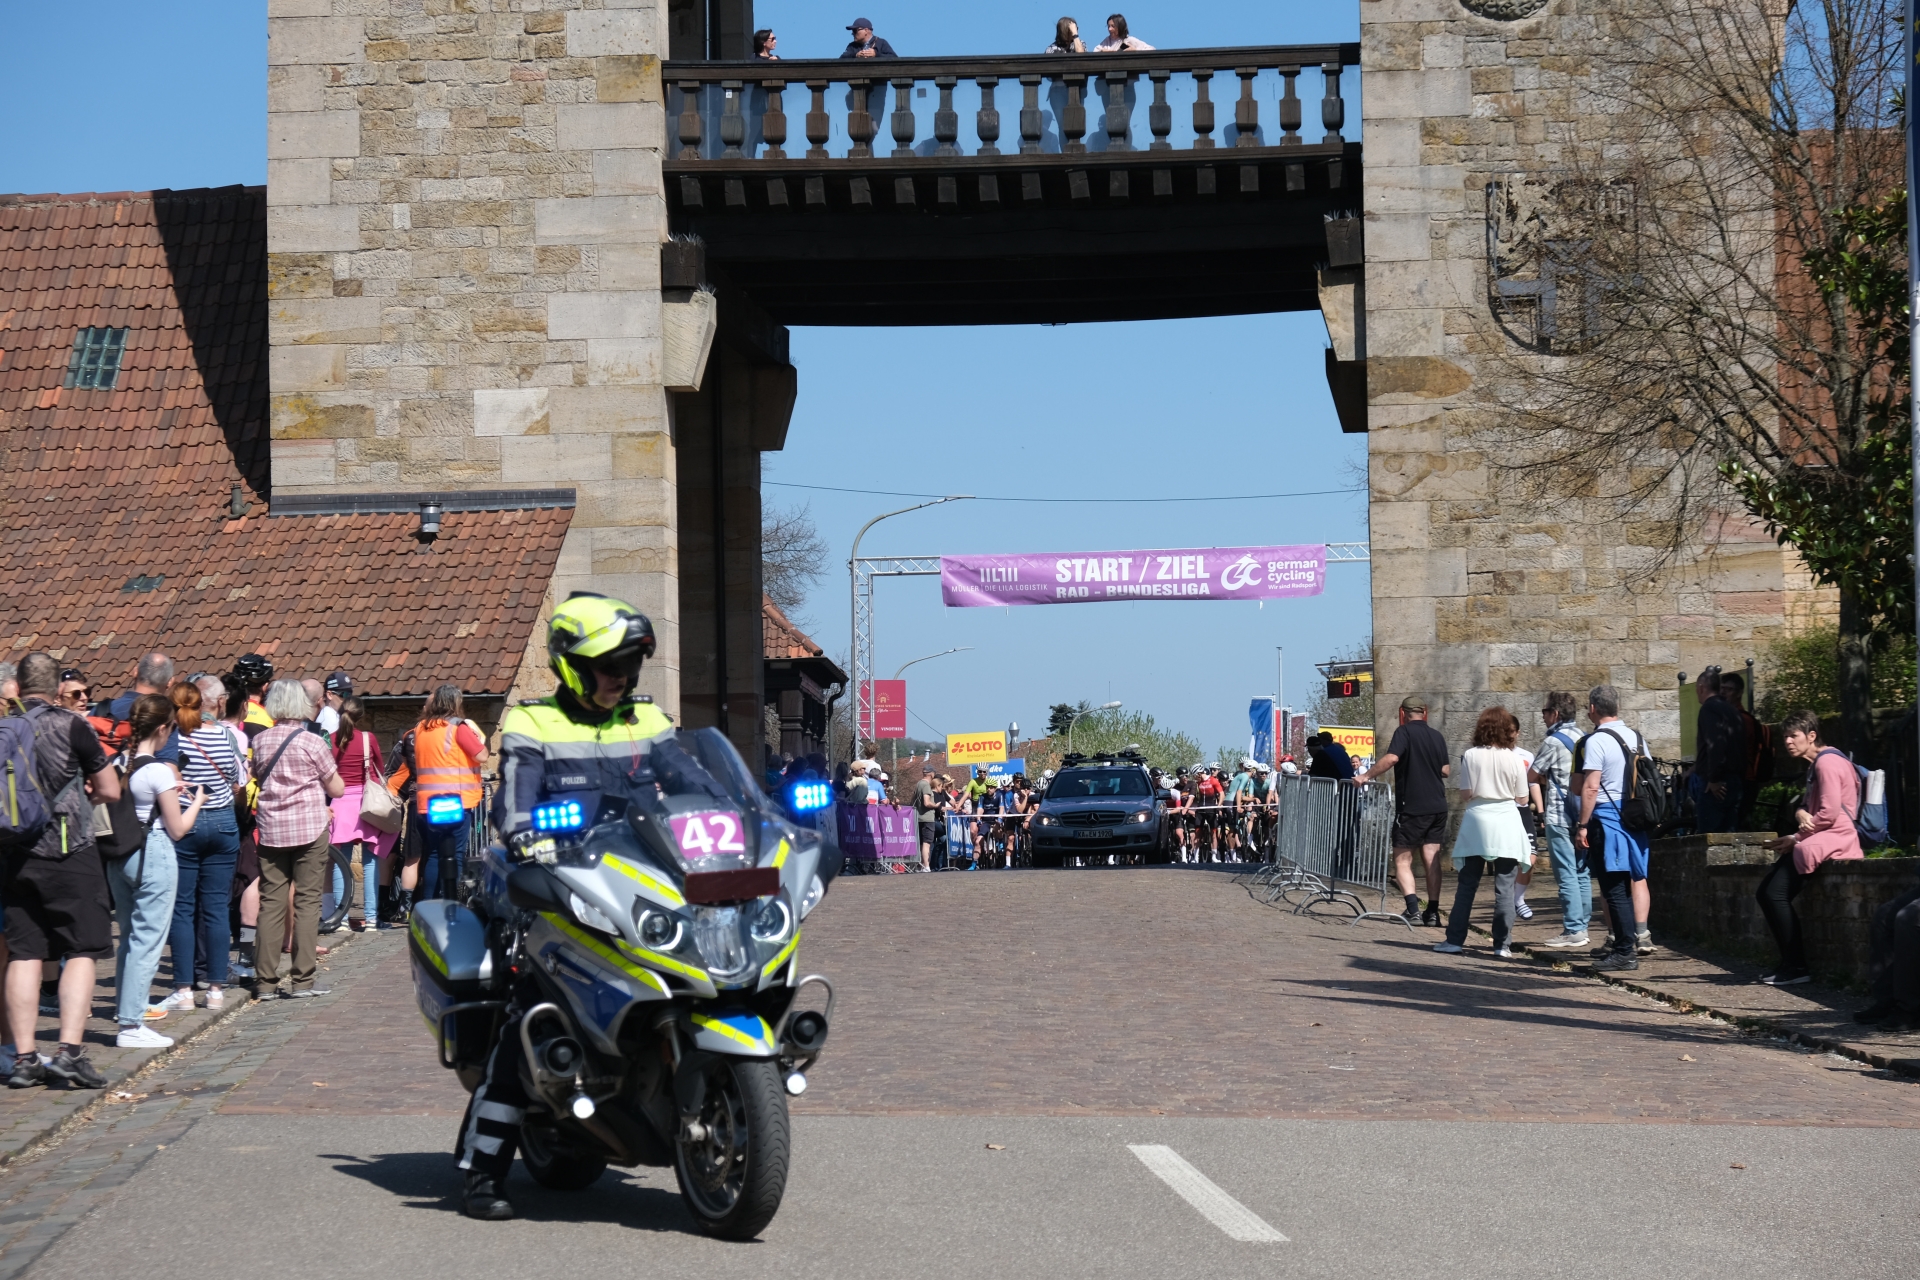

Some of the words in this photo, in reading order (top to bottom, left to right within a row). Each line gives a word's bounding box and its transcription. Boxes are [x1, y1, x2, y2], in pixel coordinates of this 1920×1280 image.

[1055, 557, 1133, 583] START
[1156, 555, 1211, 580] ZIEL
[1267, 559, 1319, 572] german
[1267, 570, 1315, 584] cycling
[951, 584, 980, 593] MÜLLER
[984, 584, 997, 592] DIE
[998, 584, 1014, 592] LILA
[1015, 583, 1048, 591] LOGISTIK
[1056, 586, 1089, 599] RAD
[1106, 583, 1211, 597] BUNDESLIGA
[1343, 682, 1352, 695] 0
[966, 740, 1003, 752] LOTTO
[1339, 735, 1375, 746] LOTTO
[561, 776, 587, 785] POLIZEI
[681, 814, 745, 853] 42
